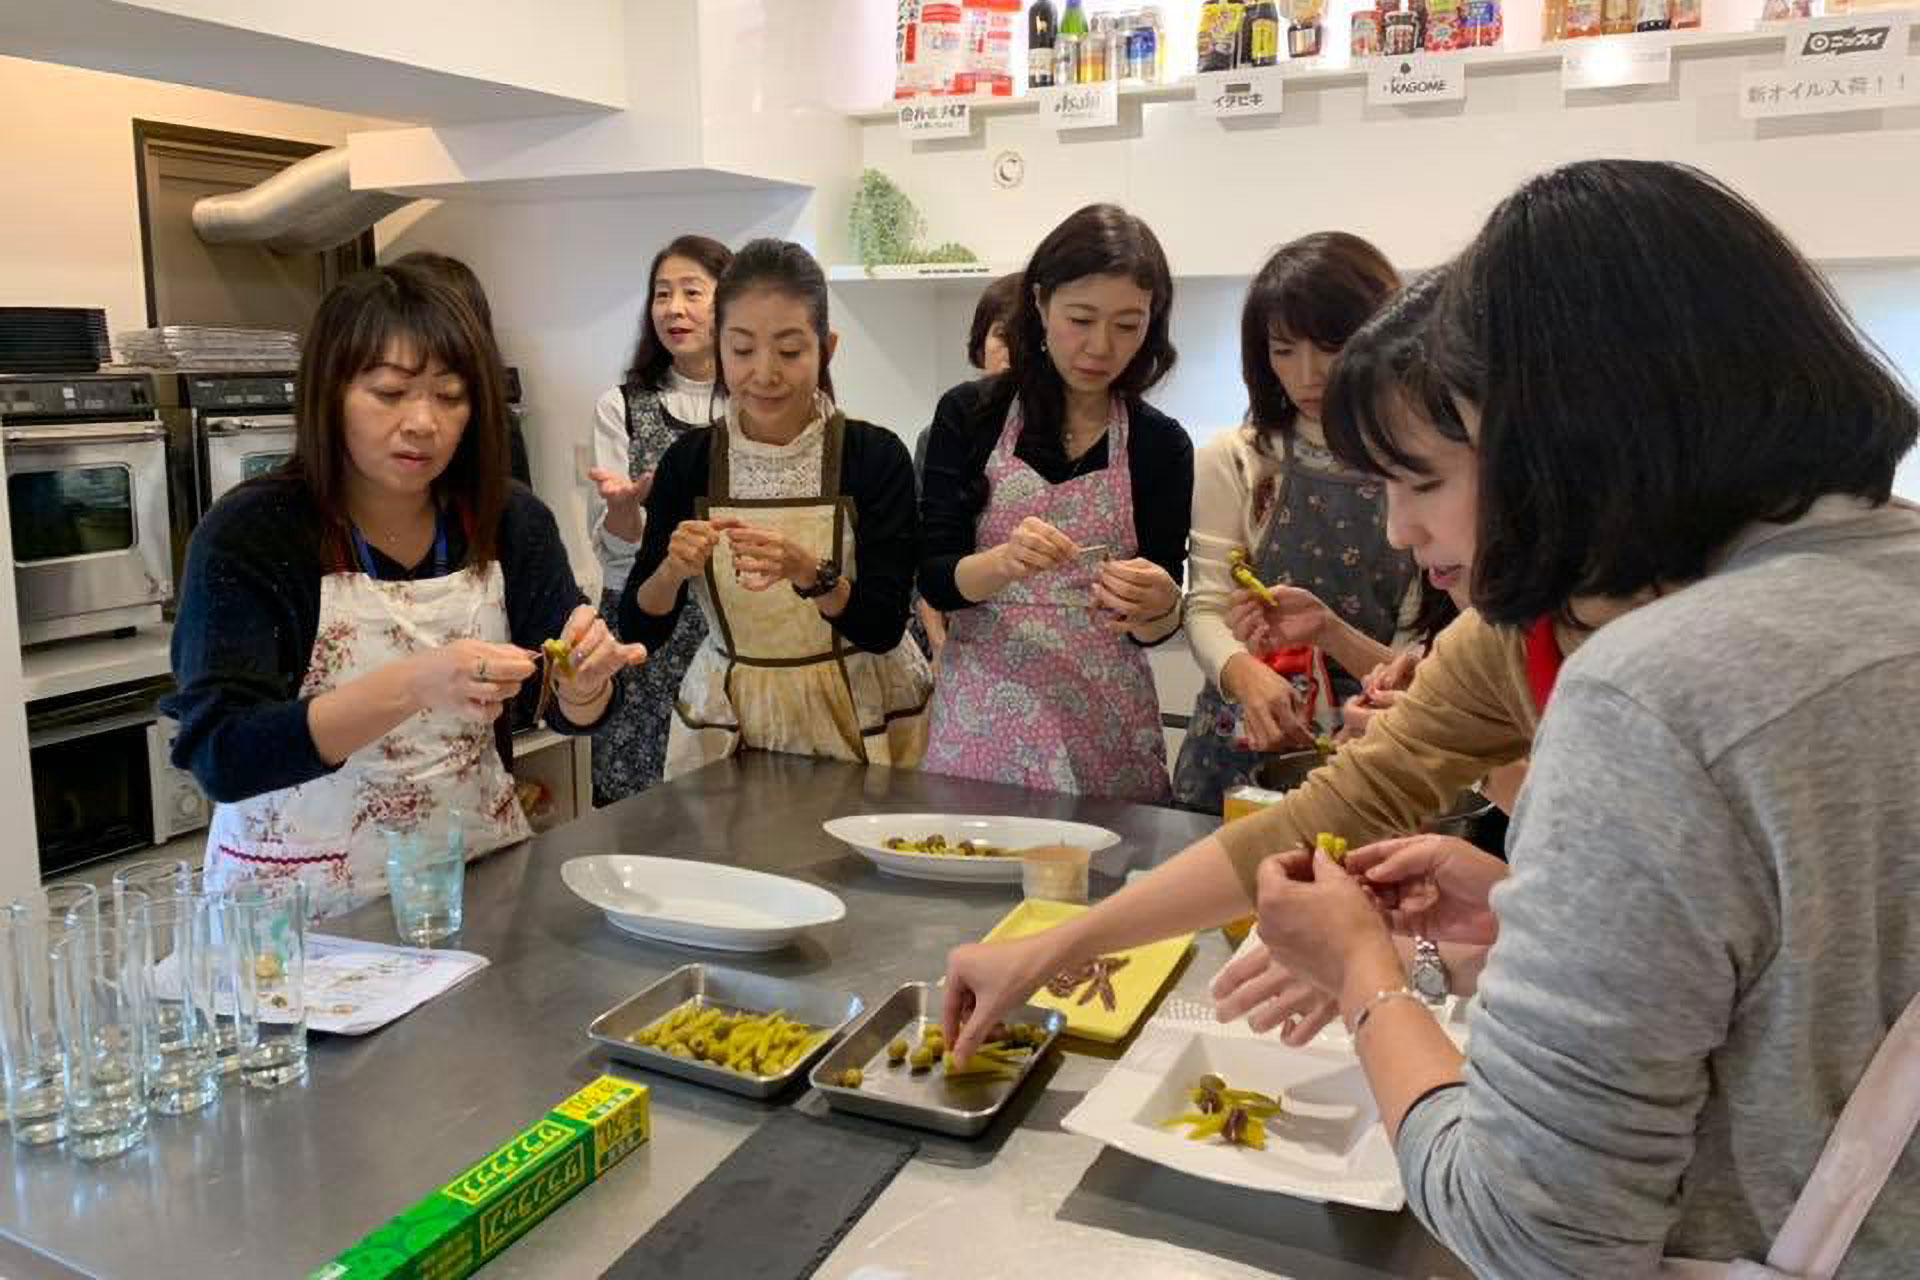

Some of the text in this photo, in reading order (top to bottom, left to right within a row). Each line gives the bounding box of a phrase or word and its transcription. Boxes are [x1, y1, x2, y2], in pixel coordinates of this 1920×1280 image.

[1829, 31, 1883, 49] ニッスイ
[1391, 77, 1447, 94] KAGOME
